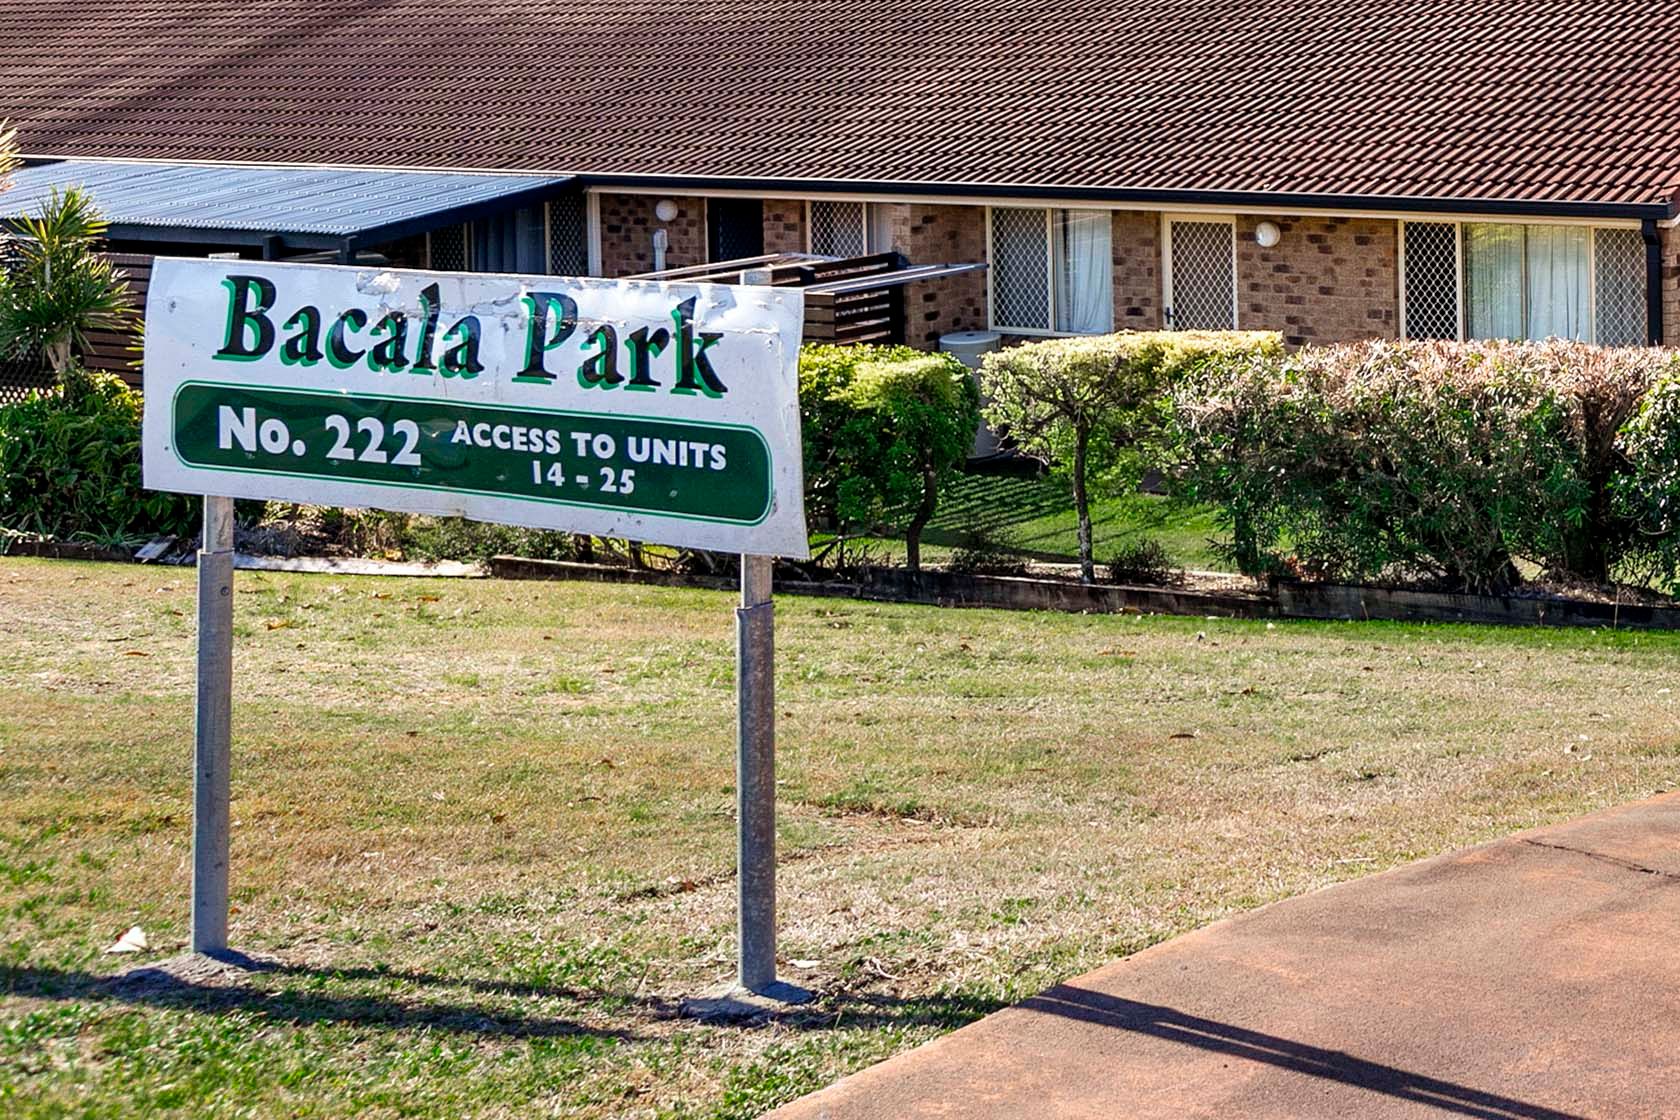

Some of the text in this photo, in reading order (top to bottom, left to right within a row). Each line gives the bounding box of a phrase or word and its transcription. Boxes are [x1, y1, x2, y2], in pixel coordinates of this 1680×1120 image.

[211, 273, 728, 399] Bacala Park
[218, 404, 728, 471] No. 222 ACCESS TO UNITS
[532, 460, 566, 488] 14
[599, 467, 635, 494] 25
